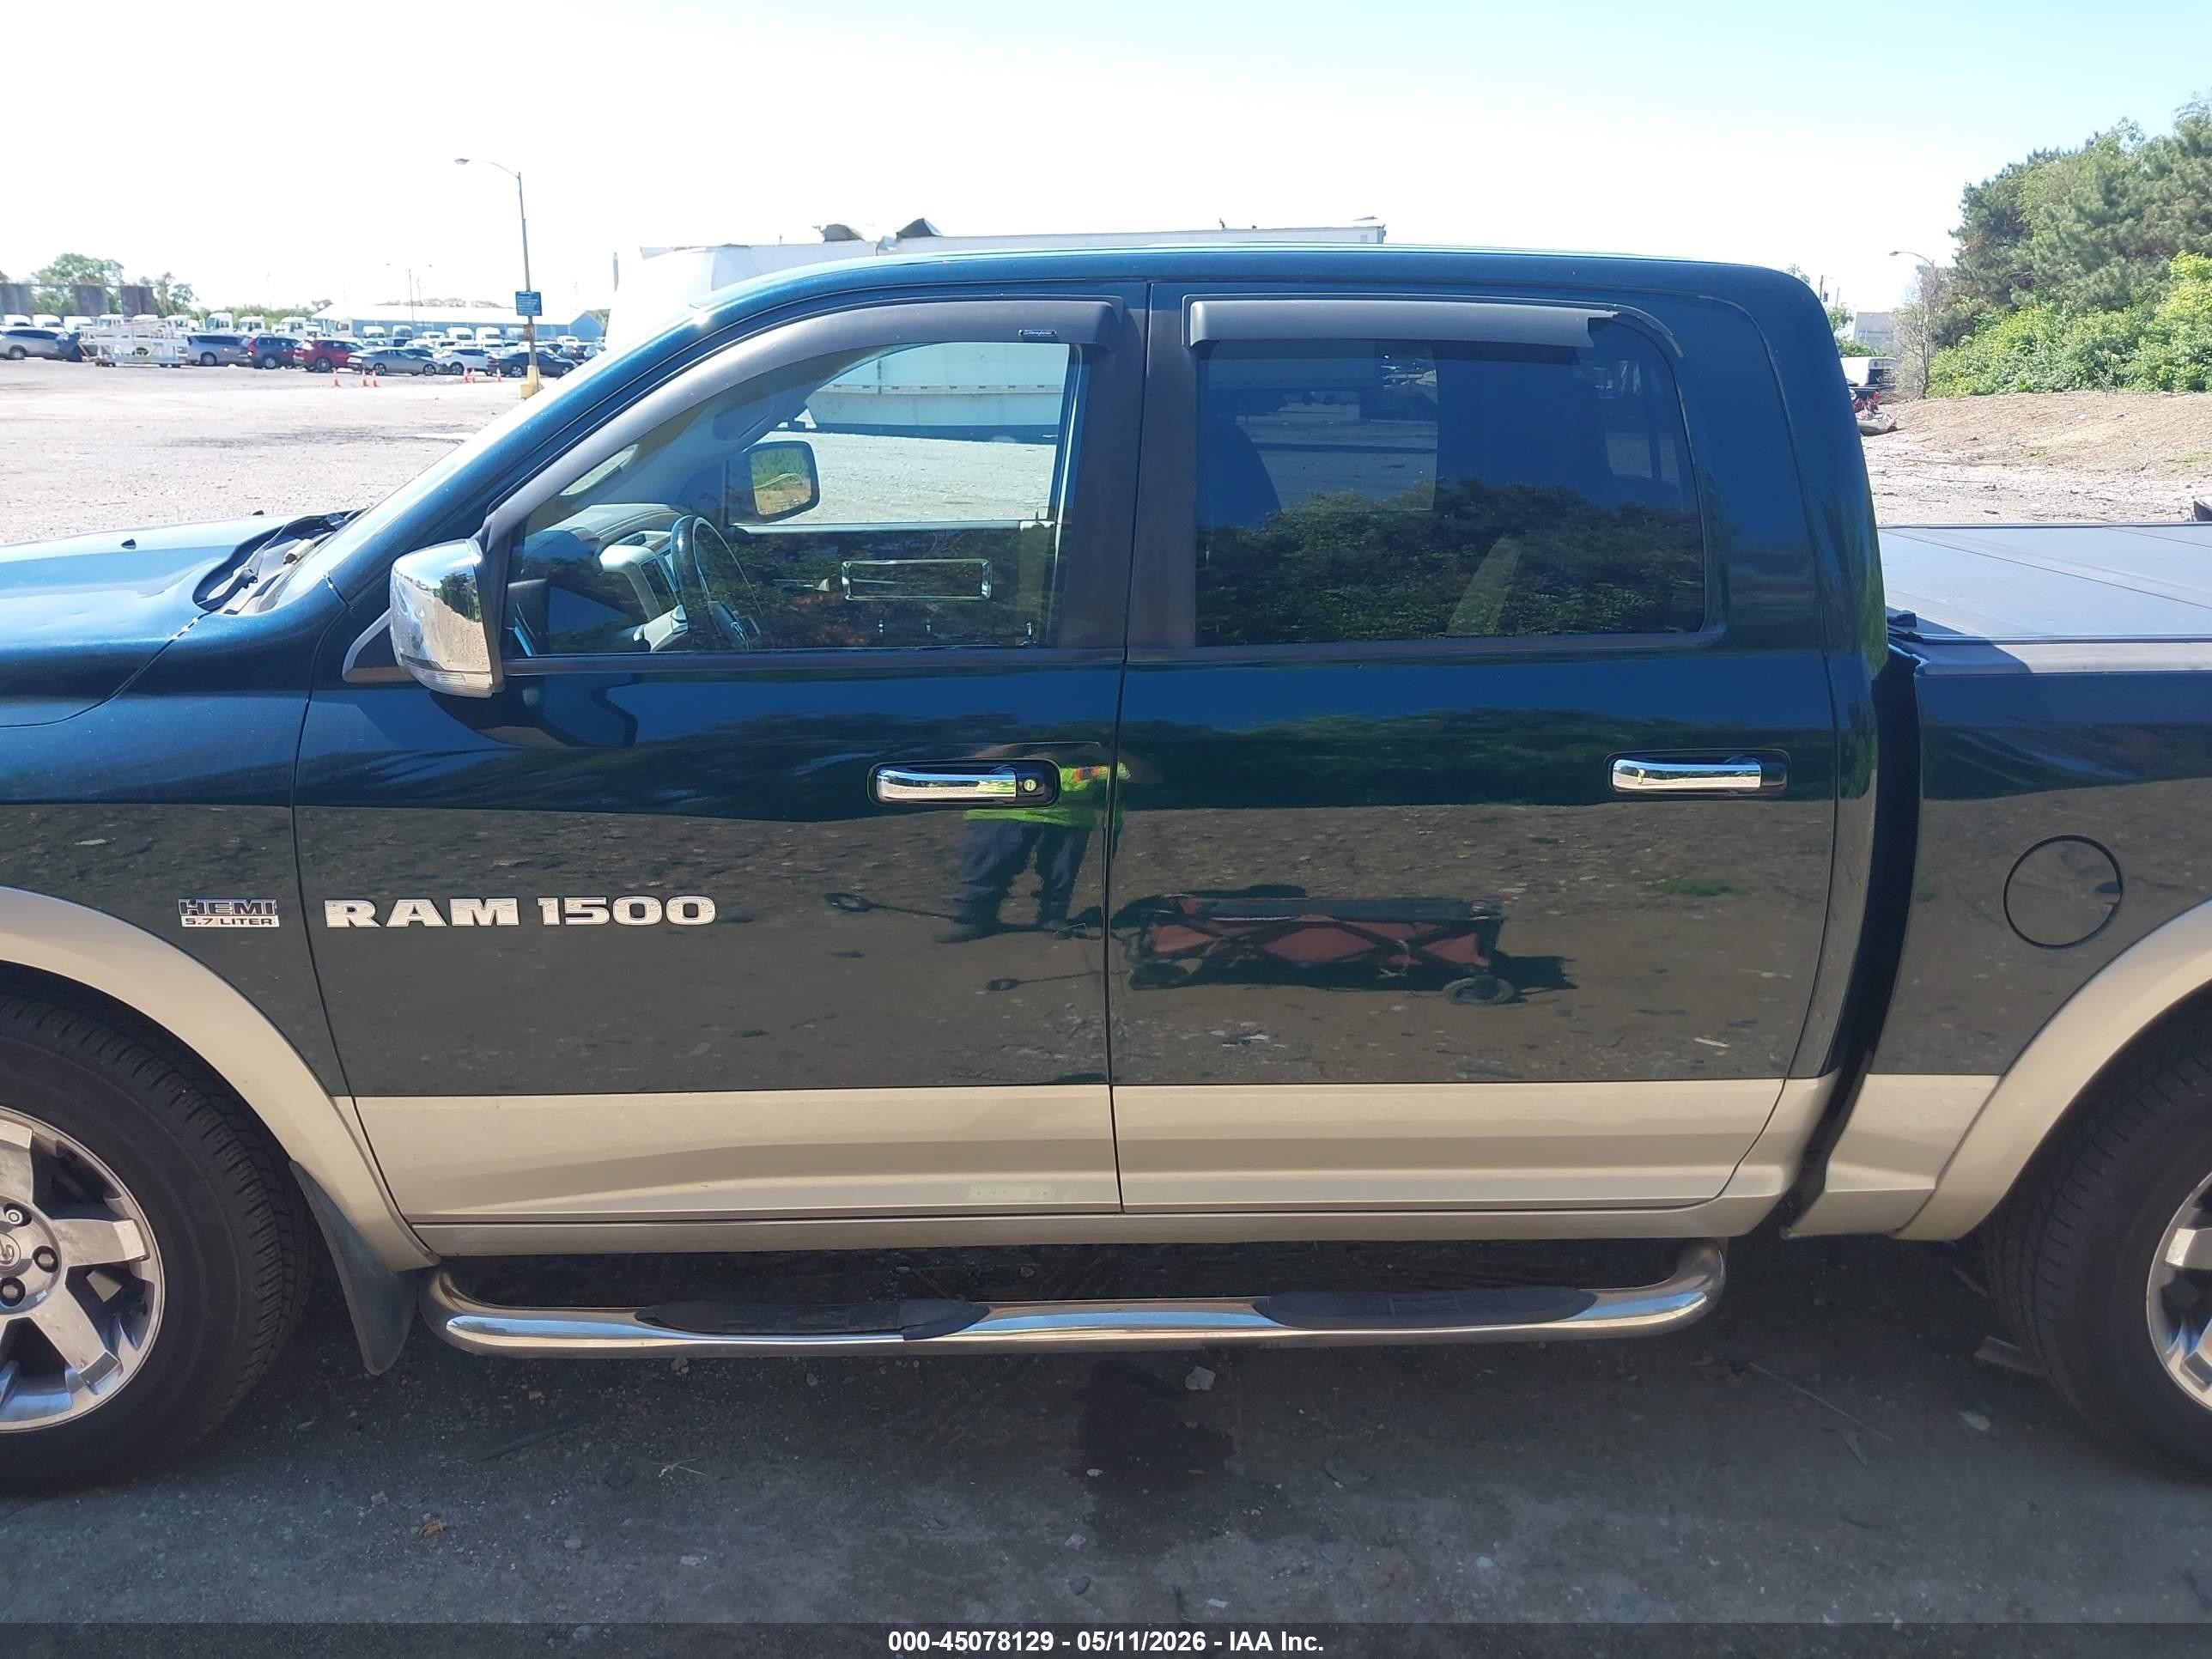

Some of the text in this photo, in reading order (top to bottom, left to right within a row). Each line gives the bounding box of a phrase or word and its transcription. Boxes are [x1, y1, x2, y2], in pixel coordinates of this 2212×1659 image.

[179, 898, 277, 915] HEMI
[324, 896, 716, 927] RAM 1500
